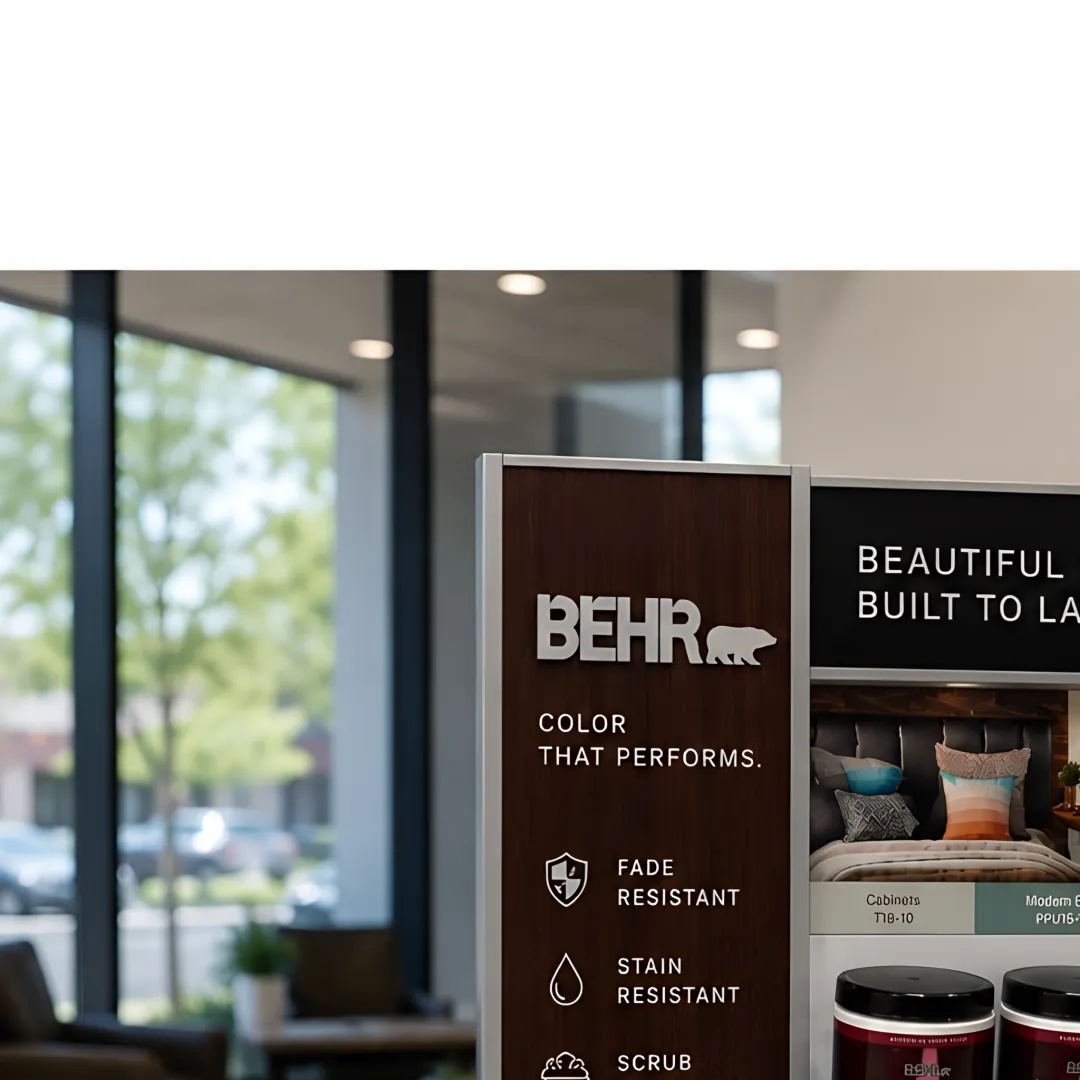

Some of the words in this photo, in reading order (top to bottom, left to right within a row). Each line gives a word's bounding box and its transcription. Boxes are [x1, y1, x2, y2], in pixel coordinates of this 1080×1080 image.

[858, 545, 1064, 579] BEAUTIFUL
[858, 590, 960, 620] BUILT
[976, 593, 1022, 622] TO
[537, 593, 704, 664] BEHR
[538, 713, 626, 734] COLOR
[538, 746, 604, 766] THAT
[617, 747, 762, 768] PERFORMS.
[618, 859, 674, 876] FADE
[618, 888, 740, 906] RESISTANT
[617, 957, 682, 975] STAIN
[618, 986, 740, 1004] RESISTANT
[617, 1054, 691, 1072] SCRUB
